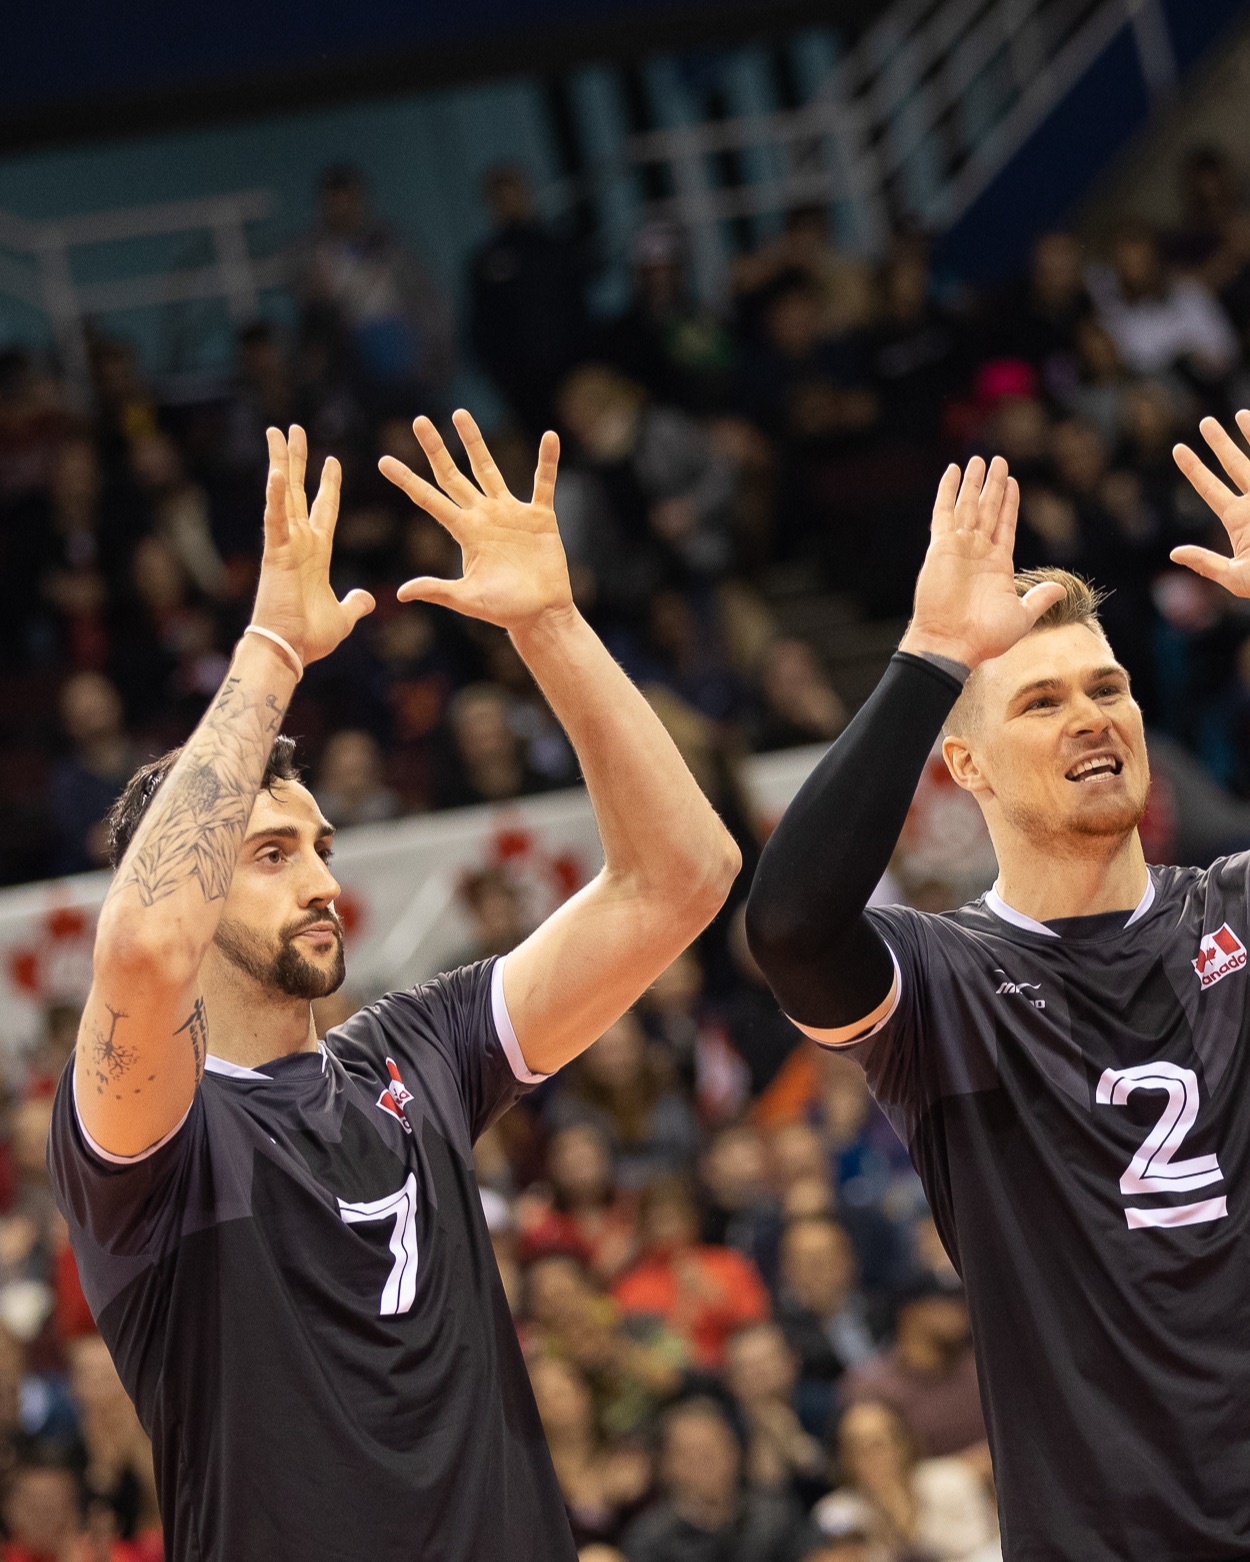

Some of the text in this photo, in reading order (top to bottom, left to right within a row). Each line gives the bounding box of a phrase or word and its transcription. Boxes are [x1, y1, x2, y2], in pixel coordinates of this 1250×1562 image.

[1201, 952, 1247, 985] anada
[1095, 1061, 1225, 1195] 2
[336, 1172, 419, 1316] 7
